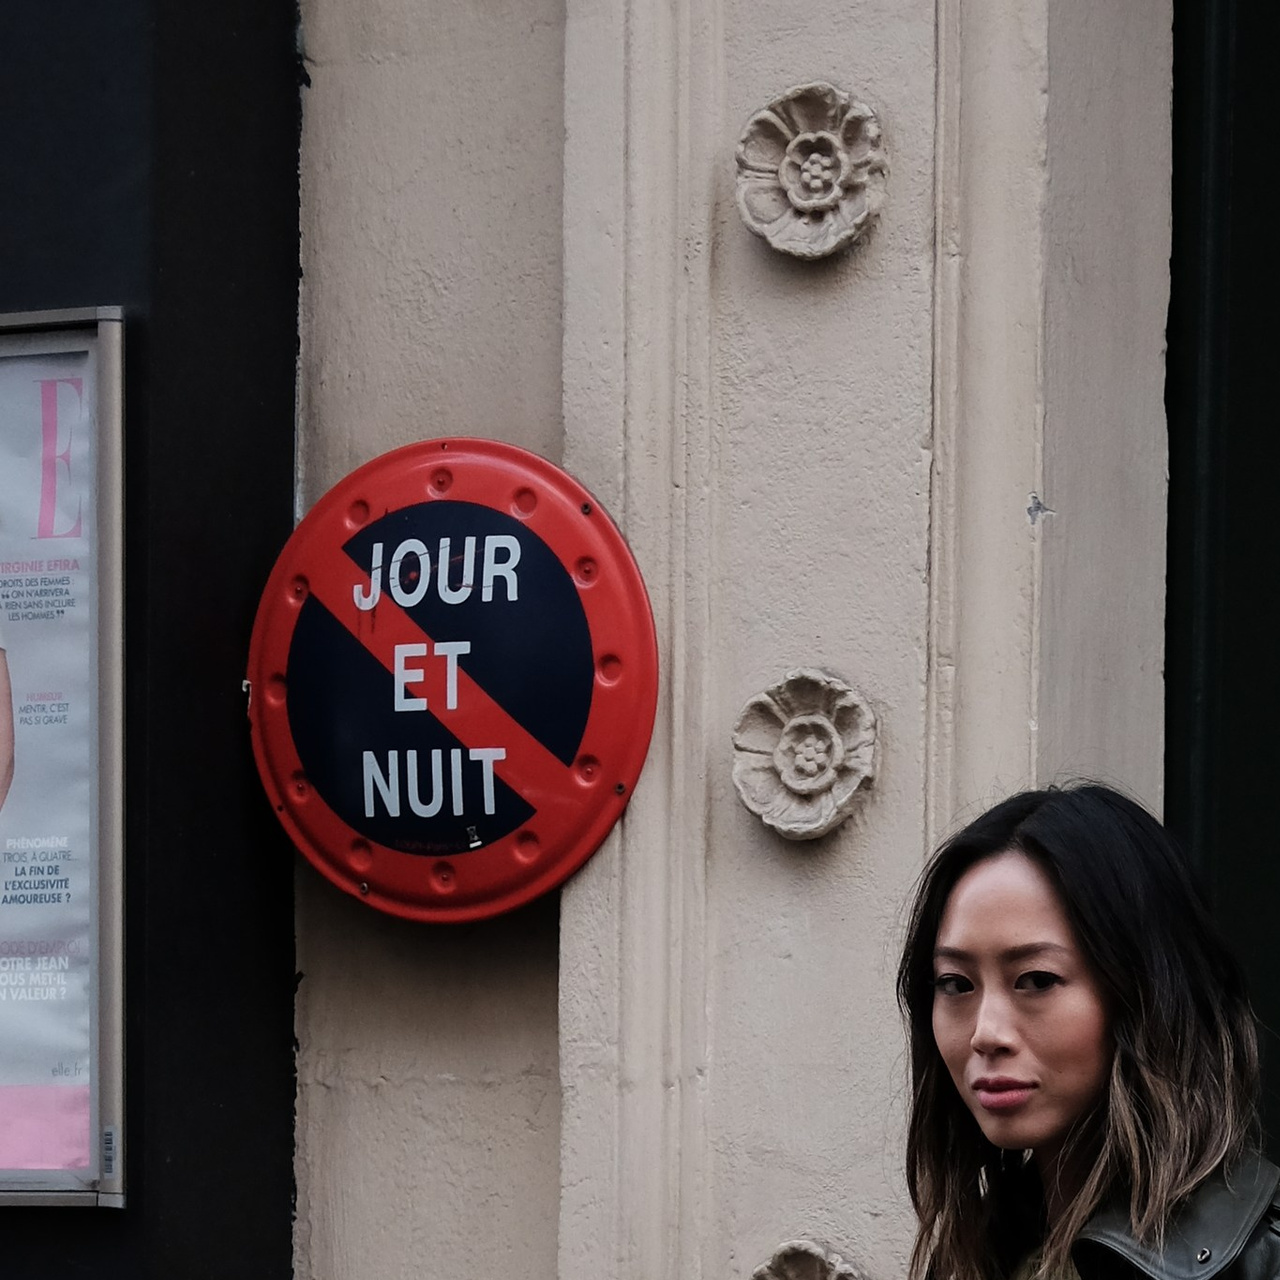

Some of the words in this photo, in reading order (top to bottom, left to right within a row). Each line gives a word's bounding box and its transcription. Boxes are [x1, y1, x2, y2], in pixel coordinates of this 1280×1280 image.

[0, 560, 44, 574] IRGINIE
[47, 558, 80, 572] EFIRA
[353, 535, 522, 610] JOUR
[25, 577, 39, 587] DES
[40, 576, 70, 586] FEMMES
[23, 600, 44, 609] SANS
[8, 611, 20, 621] LES
[394, 641, 471, 712] ET
[20, 716, 33, 725] PAS
[42, 714, 68, 724] GRAVE
[363, 748, 506, 817] NUIT
[15, 866, 26, 877] LA
[29, 865, 45, 876] FIN
[47, 864, 60, 875] DE
[2, 893, 62, 904] AMOUREUSE
[0, 956, 31, 971] OTRE
[35, 956, 69, 970] JEAN
[0, 972, 26, 986] OUS
[9, 986, 57, 1001] VALEUR
